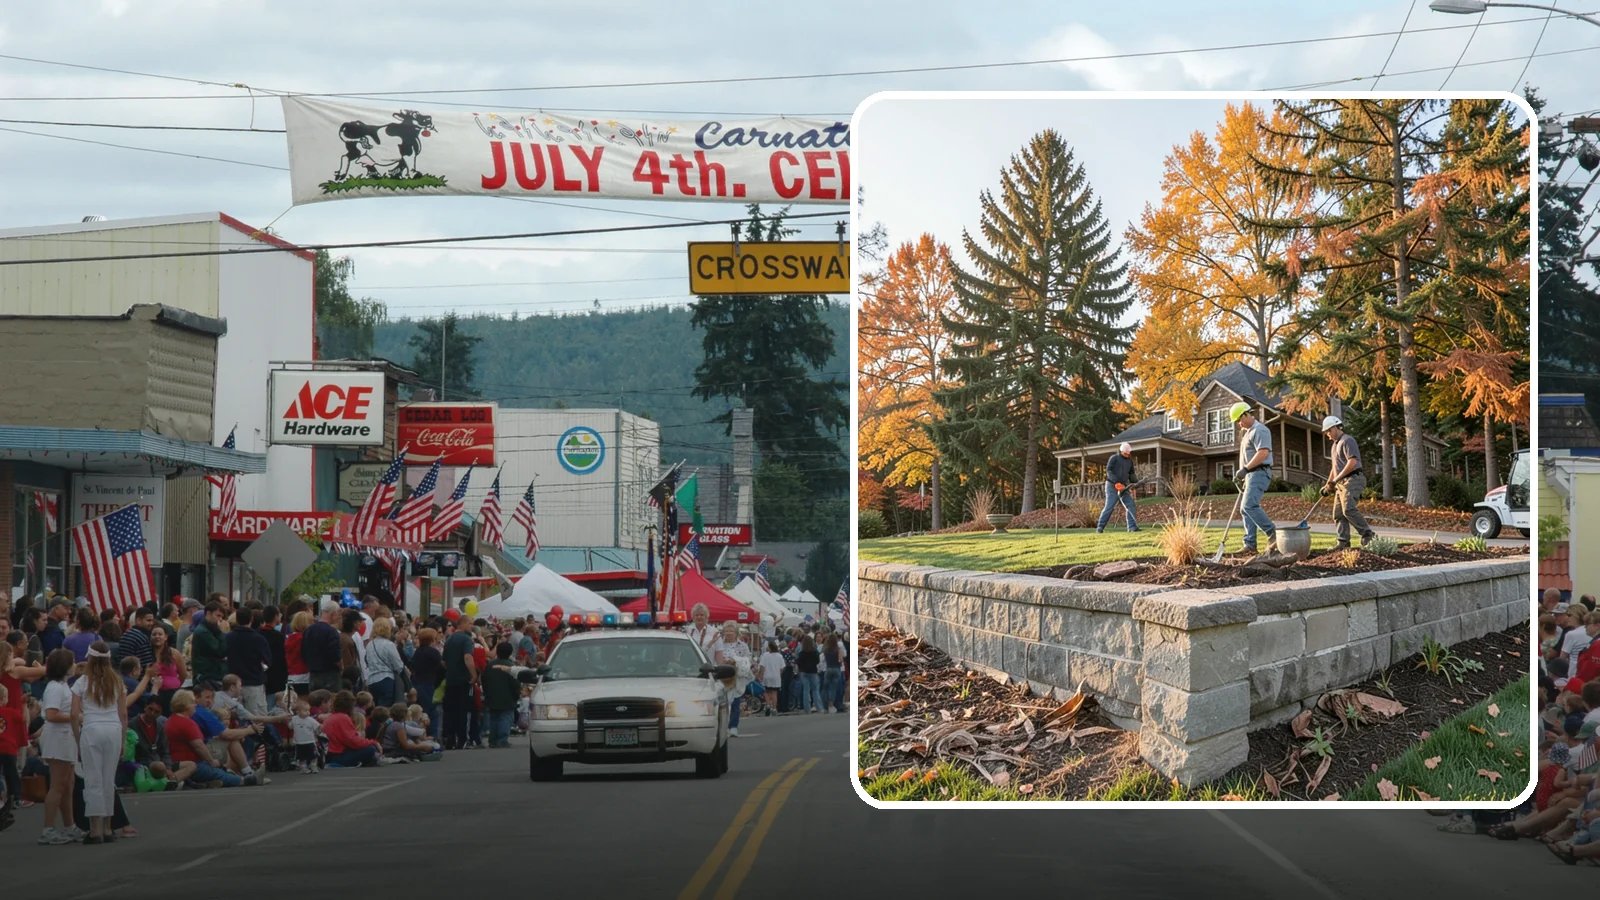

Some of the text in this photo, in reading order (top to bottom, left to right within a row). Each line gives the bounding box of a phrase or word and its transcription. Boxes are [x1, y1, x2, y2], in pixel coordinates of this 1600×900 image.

[695, 121, 850, 150] Carnat
[481, 141, 604, 193] JULY
[632, 150, 746, 198] 4th.
[697, 254, 850, 280] CROSSWA
[283, 380, 373, 420] ACE
[405, 409, 485, 422] CEDAR LOG
[283, 421, 371, 437] Hardware
[416, 428, 477, 447] Coca-Cola
[354, 467, 386, 480] Simpl
[83, 485, 155, 495] St. Vincent de Paul
[688, 526, 741, 535] CRNATION
[699, 535, 730, 543] GLASS
